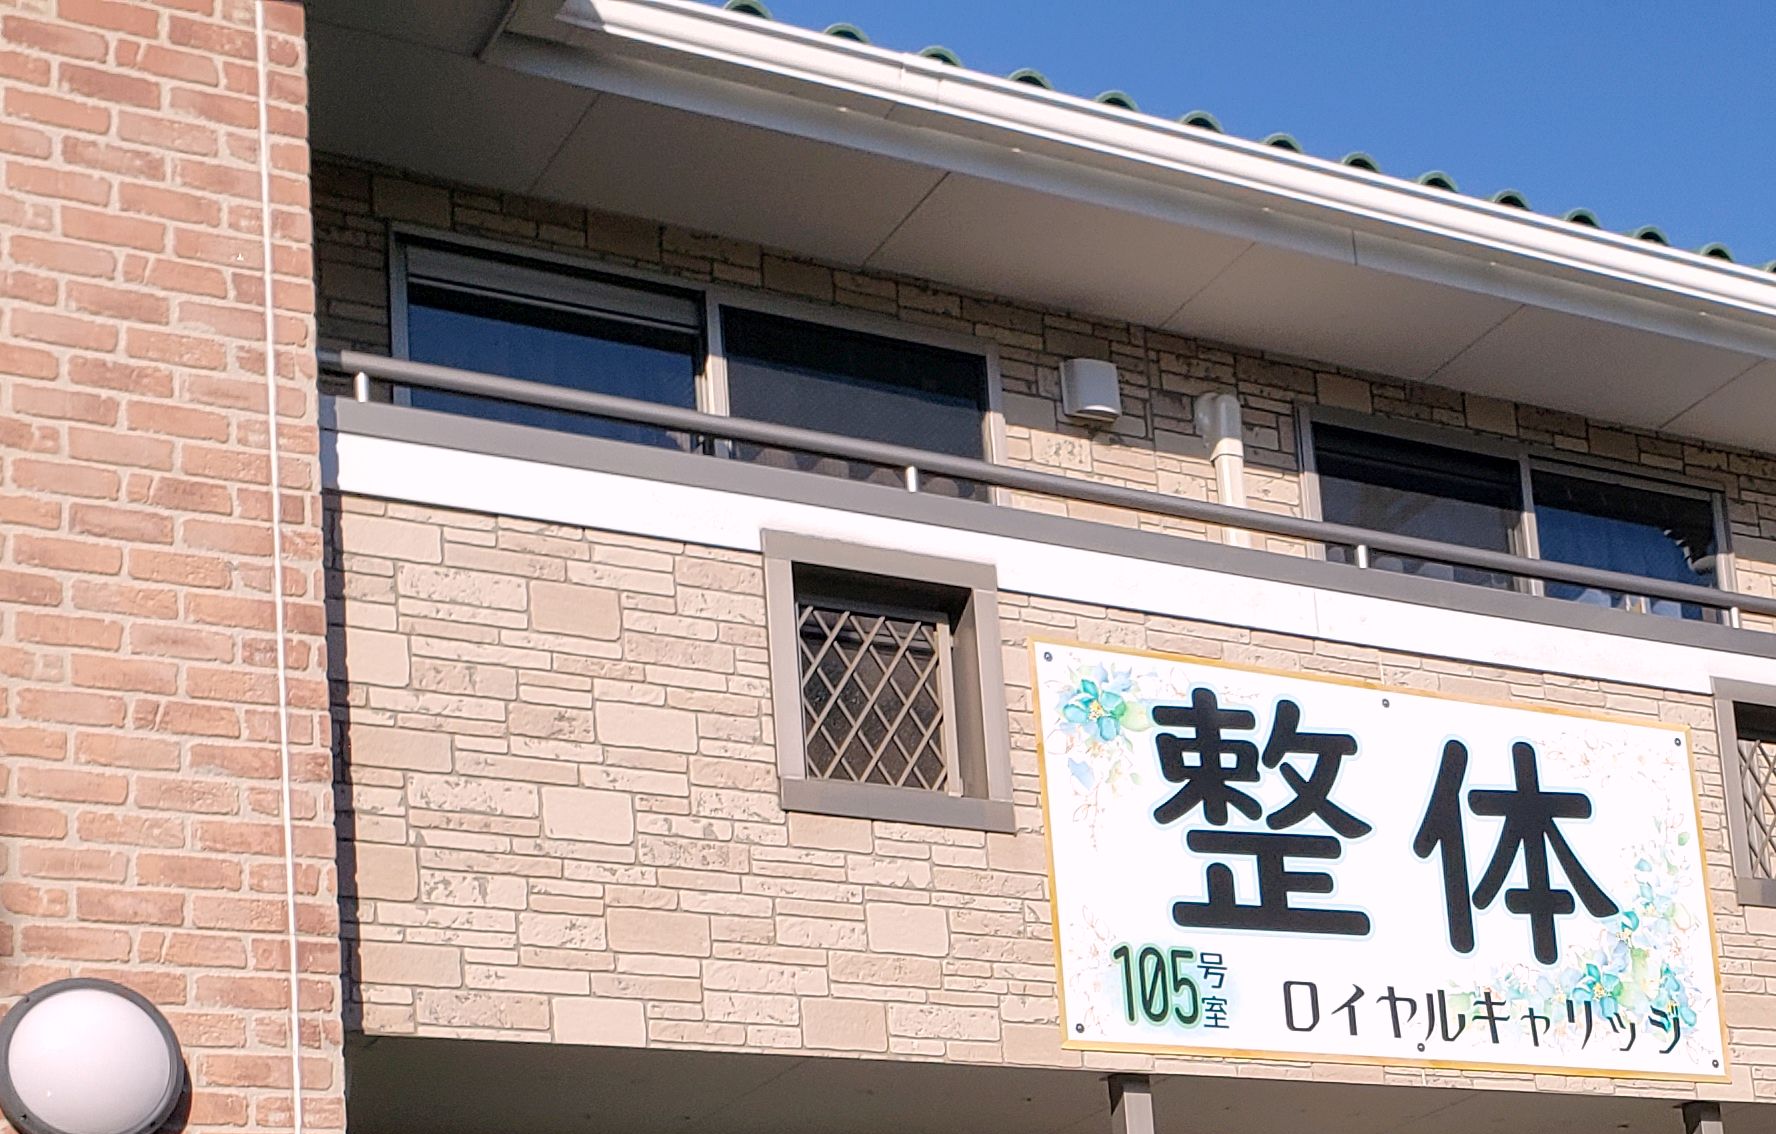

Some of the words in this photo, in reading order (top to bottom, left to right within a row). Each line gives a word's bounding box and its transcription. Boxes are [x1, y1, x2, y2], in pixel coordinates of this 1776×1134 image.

[1151, 686, 1621, 966] 整体
[1282, 980, 1682, 1055] ロイヤルキャリッジ
